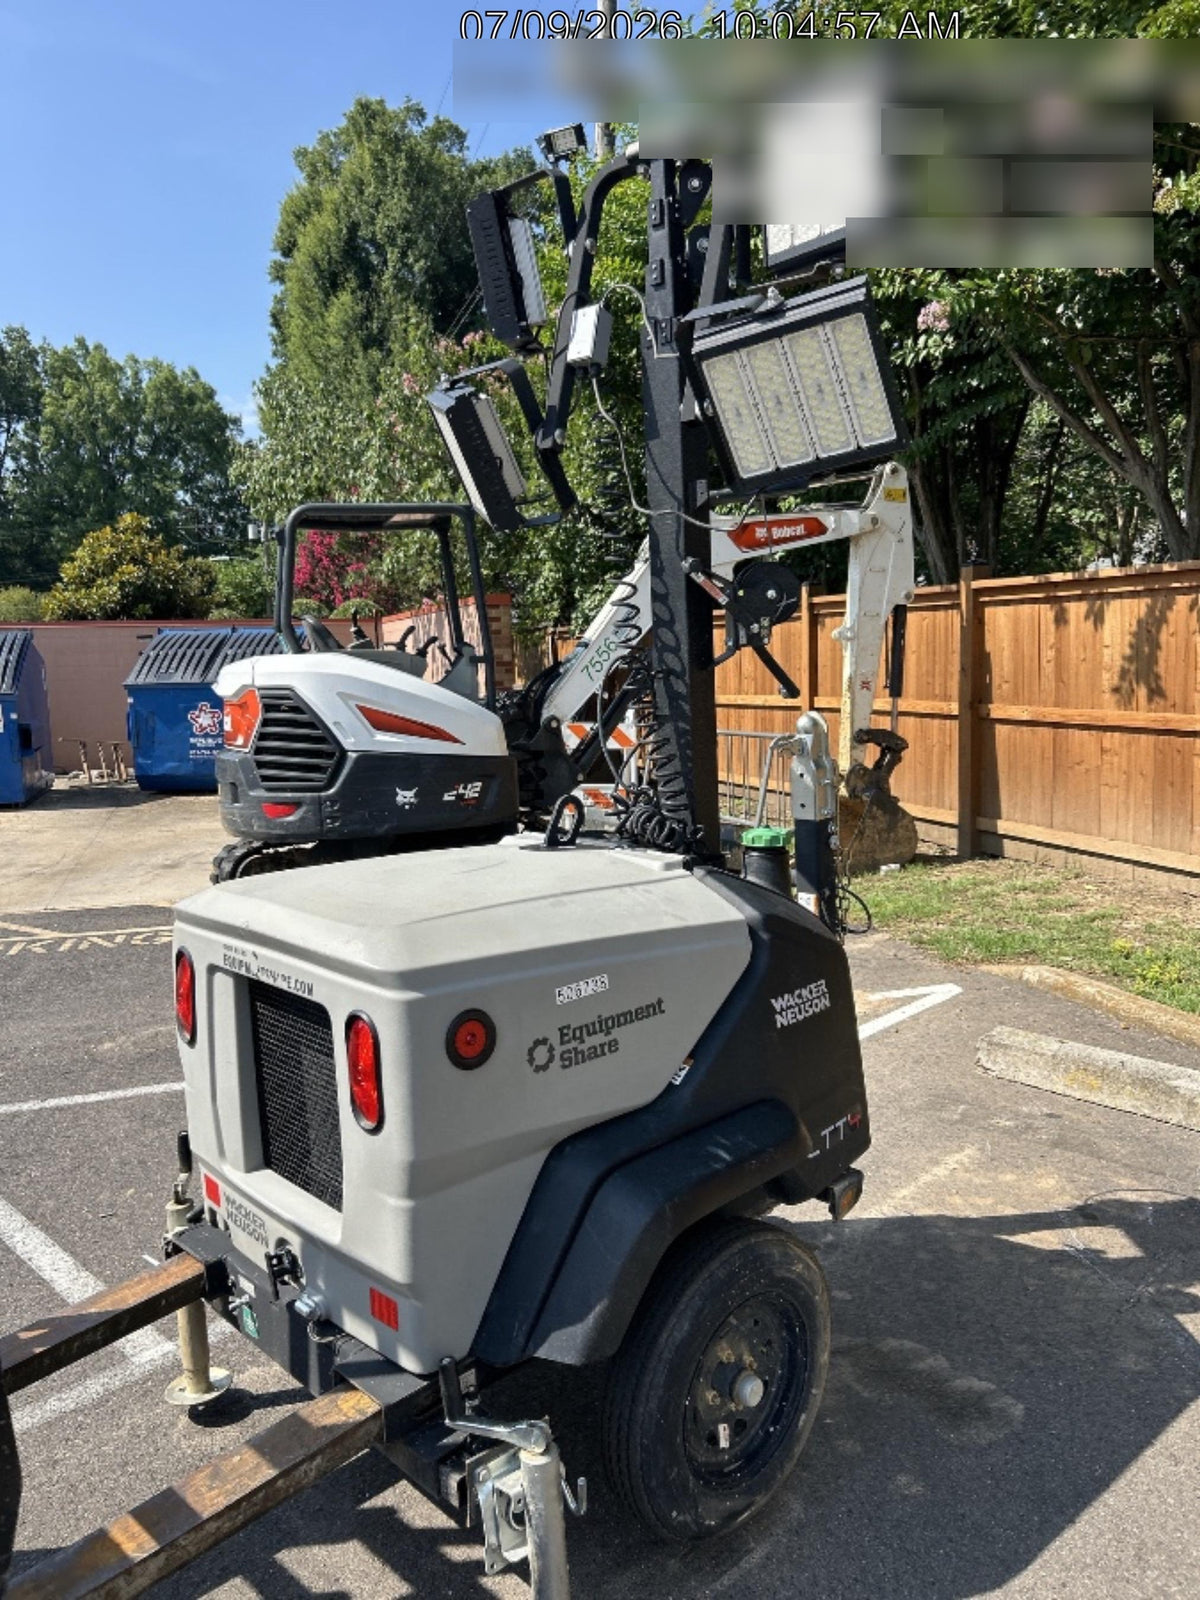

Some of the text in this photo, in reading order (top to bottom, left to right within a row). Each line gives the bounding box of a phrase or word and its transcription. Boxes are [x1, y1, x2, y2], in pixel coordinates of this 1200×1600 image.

[771, 524, 806, 540] Bobcat
[770, 979, 828, 1012] WACKER
[775, 993, 830, 1028] NEUSON
[558, 997, 665, 1046] Equipment
[559, 1037, 619, 1069] Share
